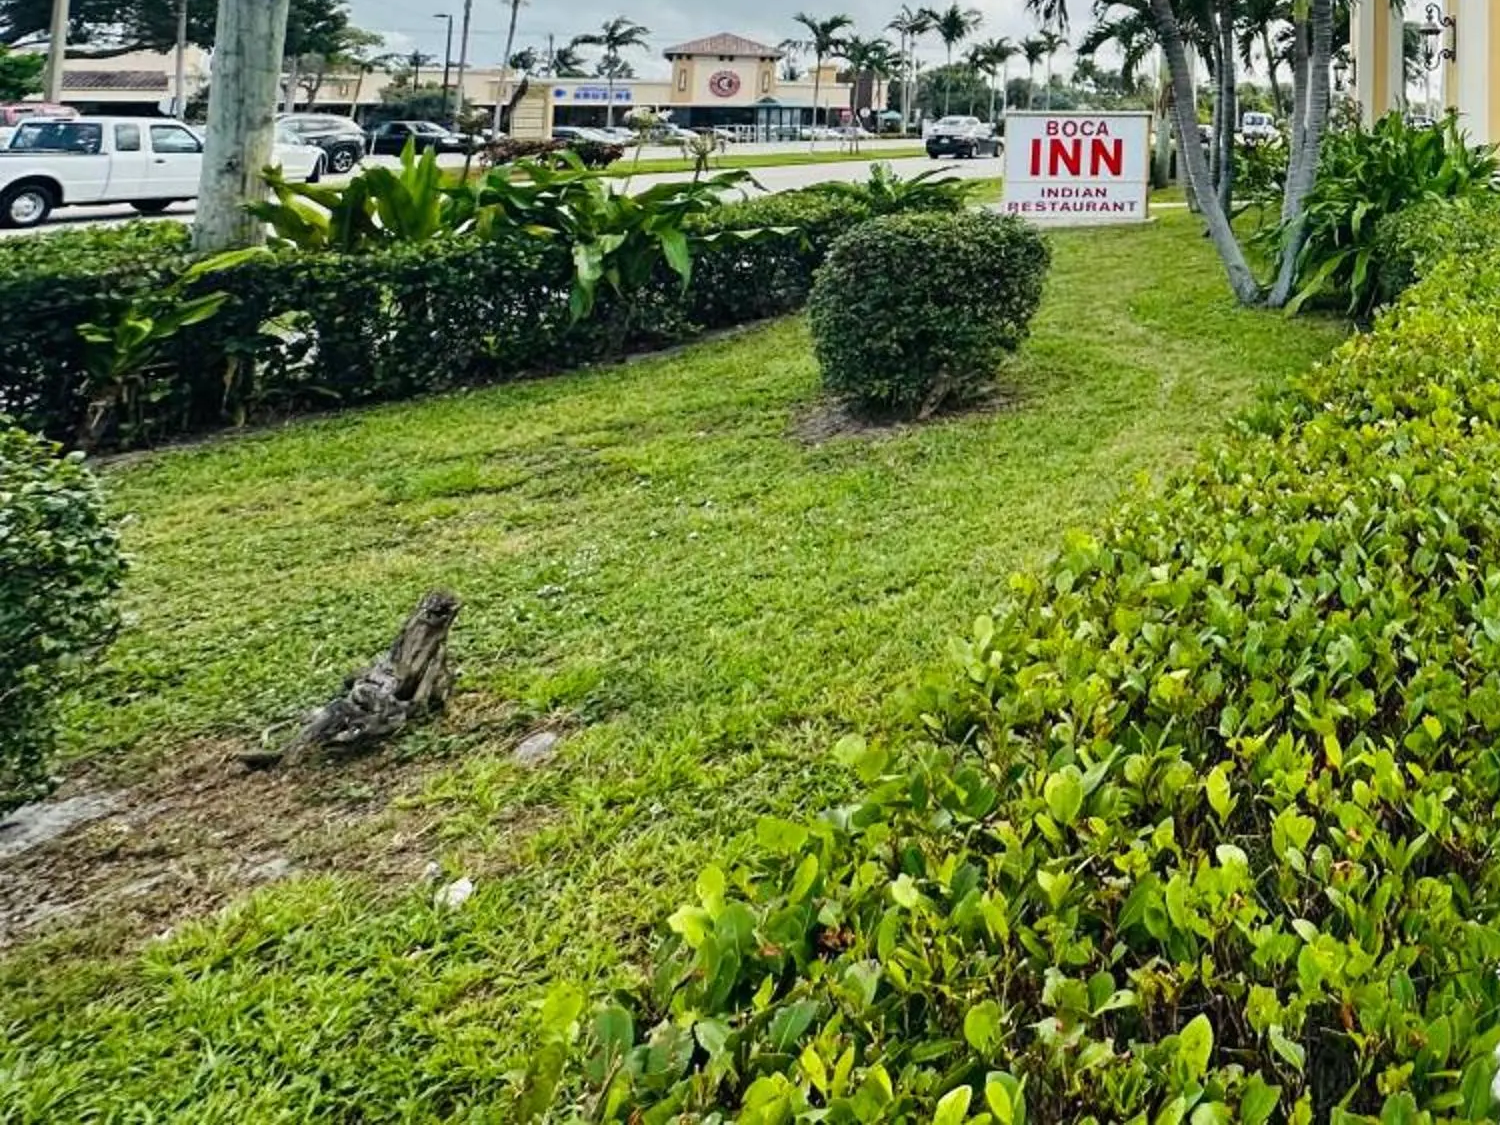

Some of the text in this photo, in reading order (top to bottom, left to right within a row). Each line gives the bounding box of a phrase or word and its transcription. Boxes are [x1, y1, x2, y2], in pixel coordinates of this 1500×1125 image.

[1045, 120, 1110, 137] BOCA
[1029, 138, 1123, 177] INN
[1041, 187, 1107, 198] INDIAN
[1006, 200, 1138, 213] RESTAURANT
